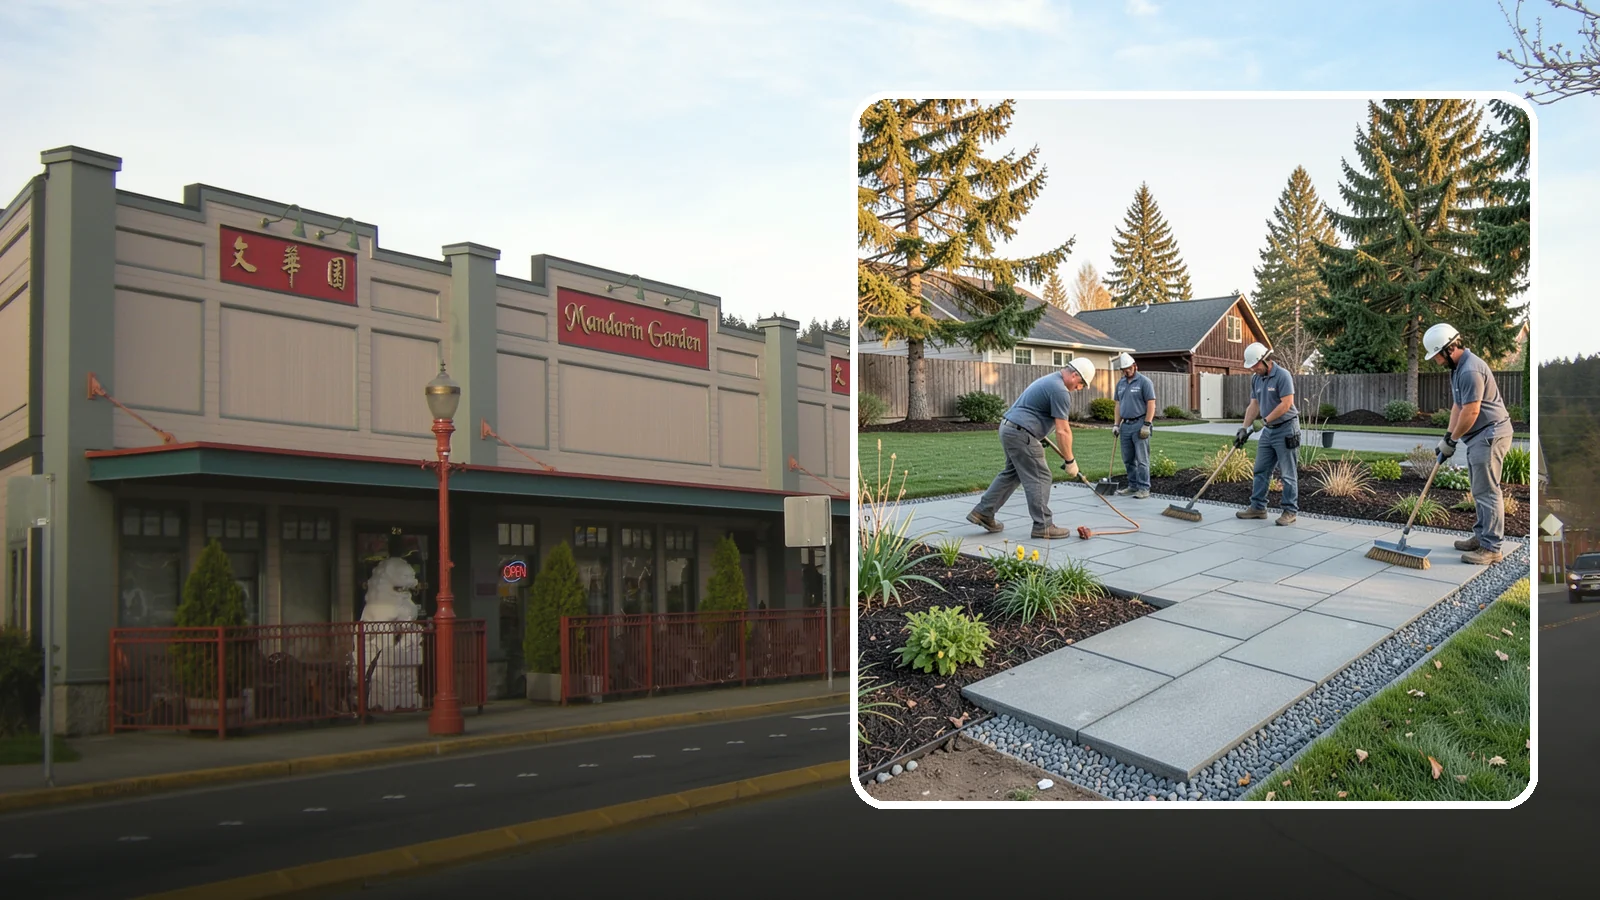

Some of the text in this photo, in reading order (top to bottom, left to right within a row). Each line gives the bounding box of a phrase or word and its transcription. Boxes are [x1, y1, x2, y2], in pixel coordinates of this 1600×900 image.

[231, 235, 346, 291] 文華園
[564, 302, 702, 352] Mandarin Garden
[503, 565, 527, 578] OPEN
